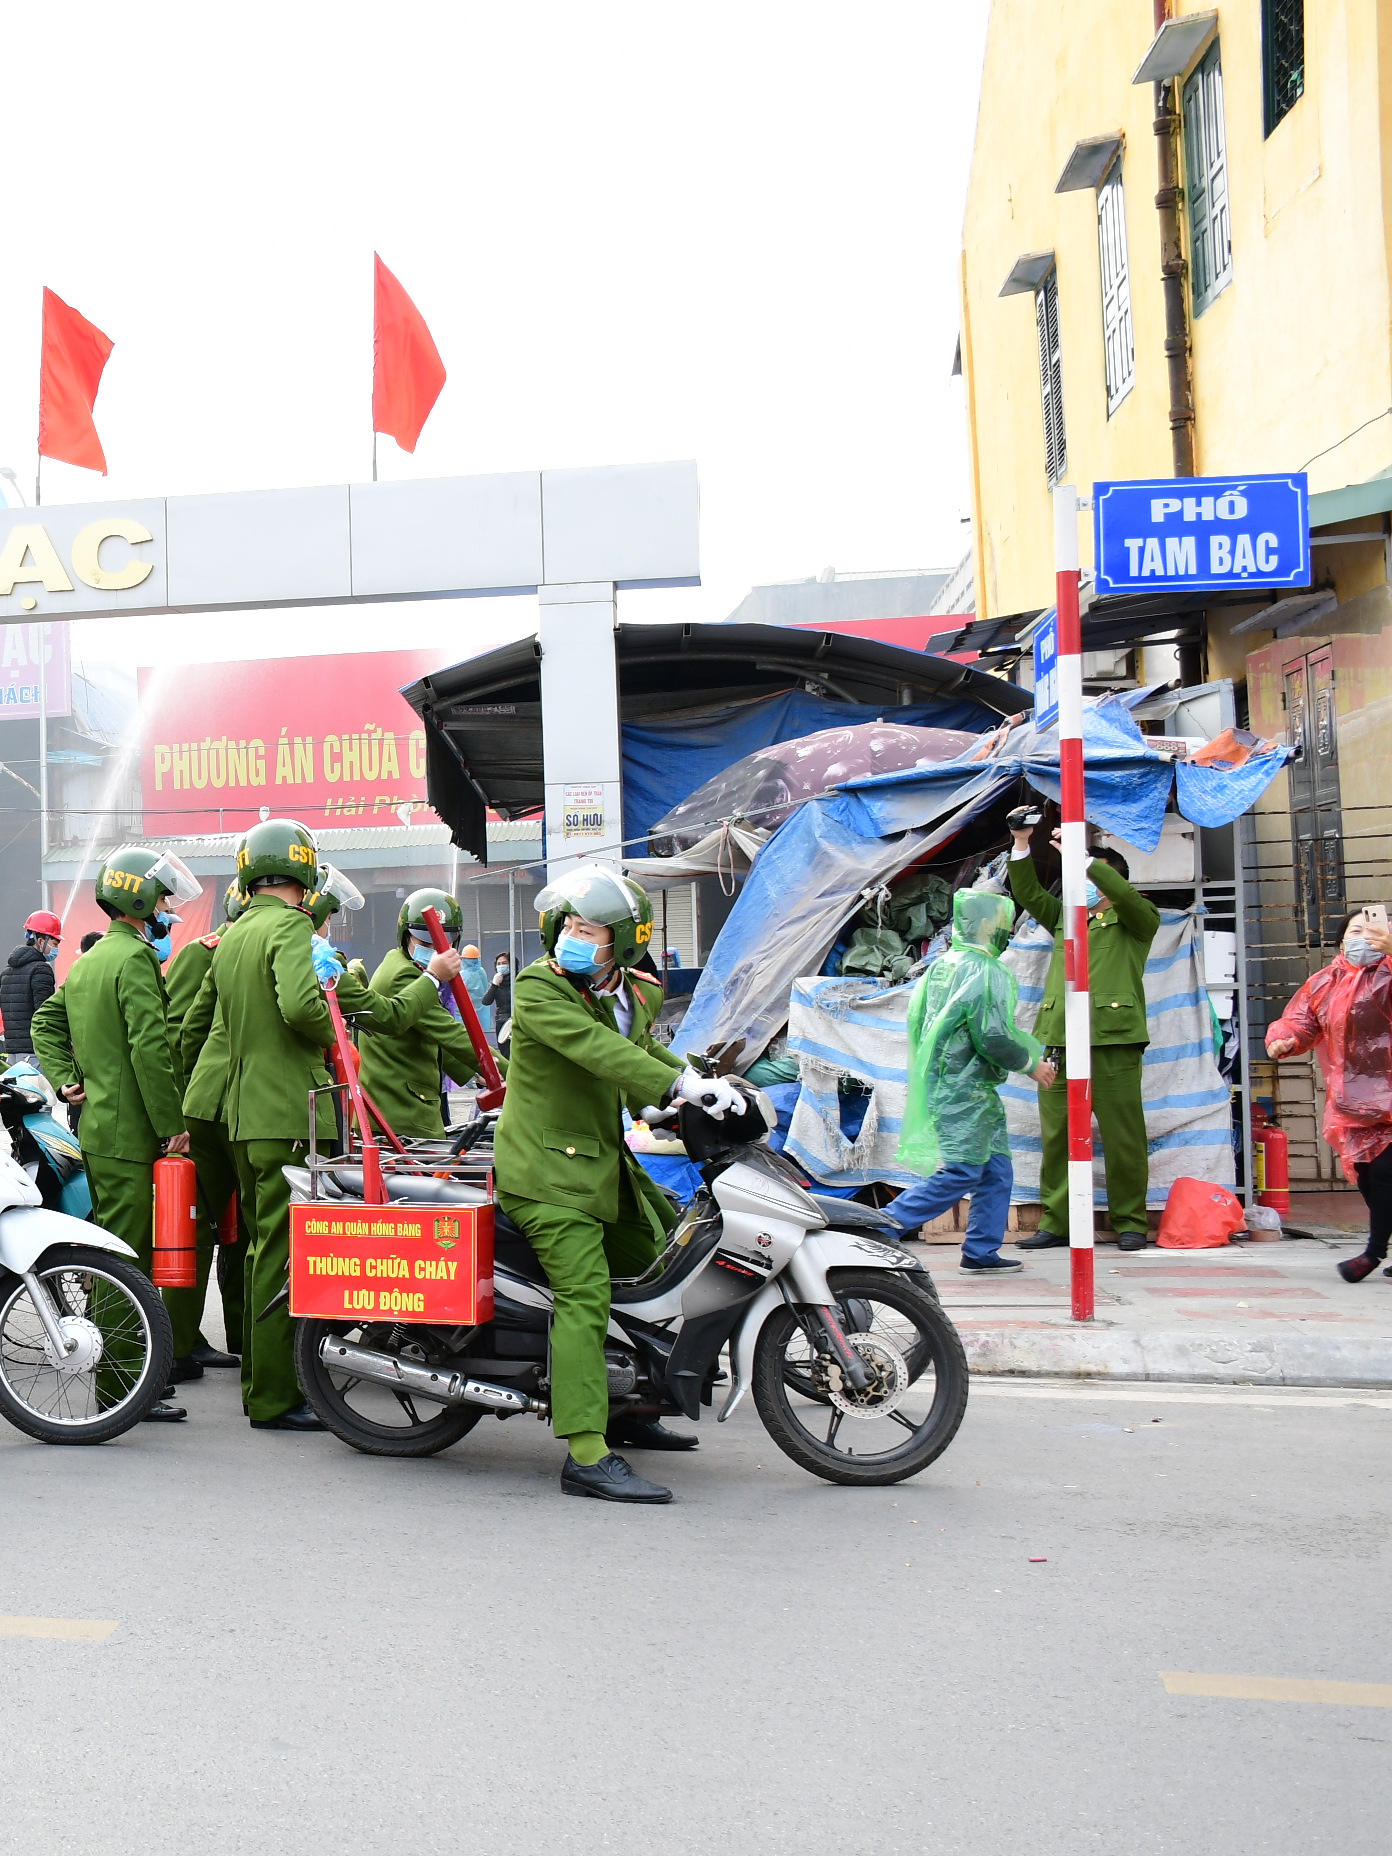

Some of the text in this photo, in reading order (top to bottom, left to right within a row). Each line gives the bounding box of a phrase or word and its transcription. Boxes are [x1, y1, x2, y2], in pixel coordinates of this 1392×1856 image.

[1151, 486, 1248, 523] PHỐ
[1124, 532, 1279, 578] TAM BẠC
[154, 735, 266, 790] PHƯƠNG
[275, 727, 314, 785] ÁN
[323, 723, 400, 782] CHỮA
[324, 796, 366, 816] Hải
[103, 869, 145, 894] CSTT
[305, 1219, 329, 1234] CÔNG
[330, 1222, 343, 1234] AN
[345, 1220, 369, 1237] QUẬN
[307, 1253, 458, 1280] THÙNG CHỮA CHÁY
[343, 1288, 425, 1315] LƯU ĐỘNG
